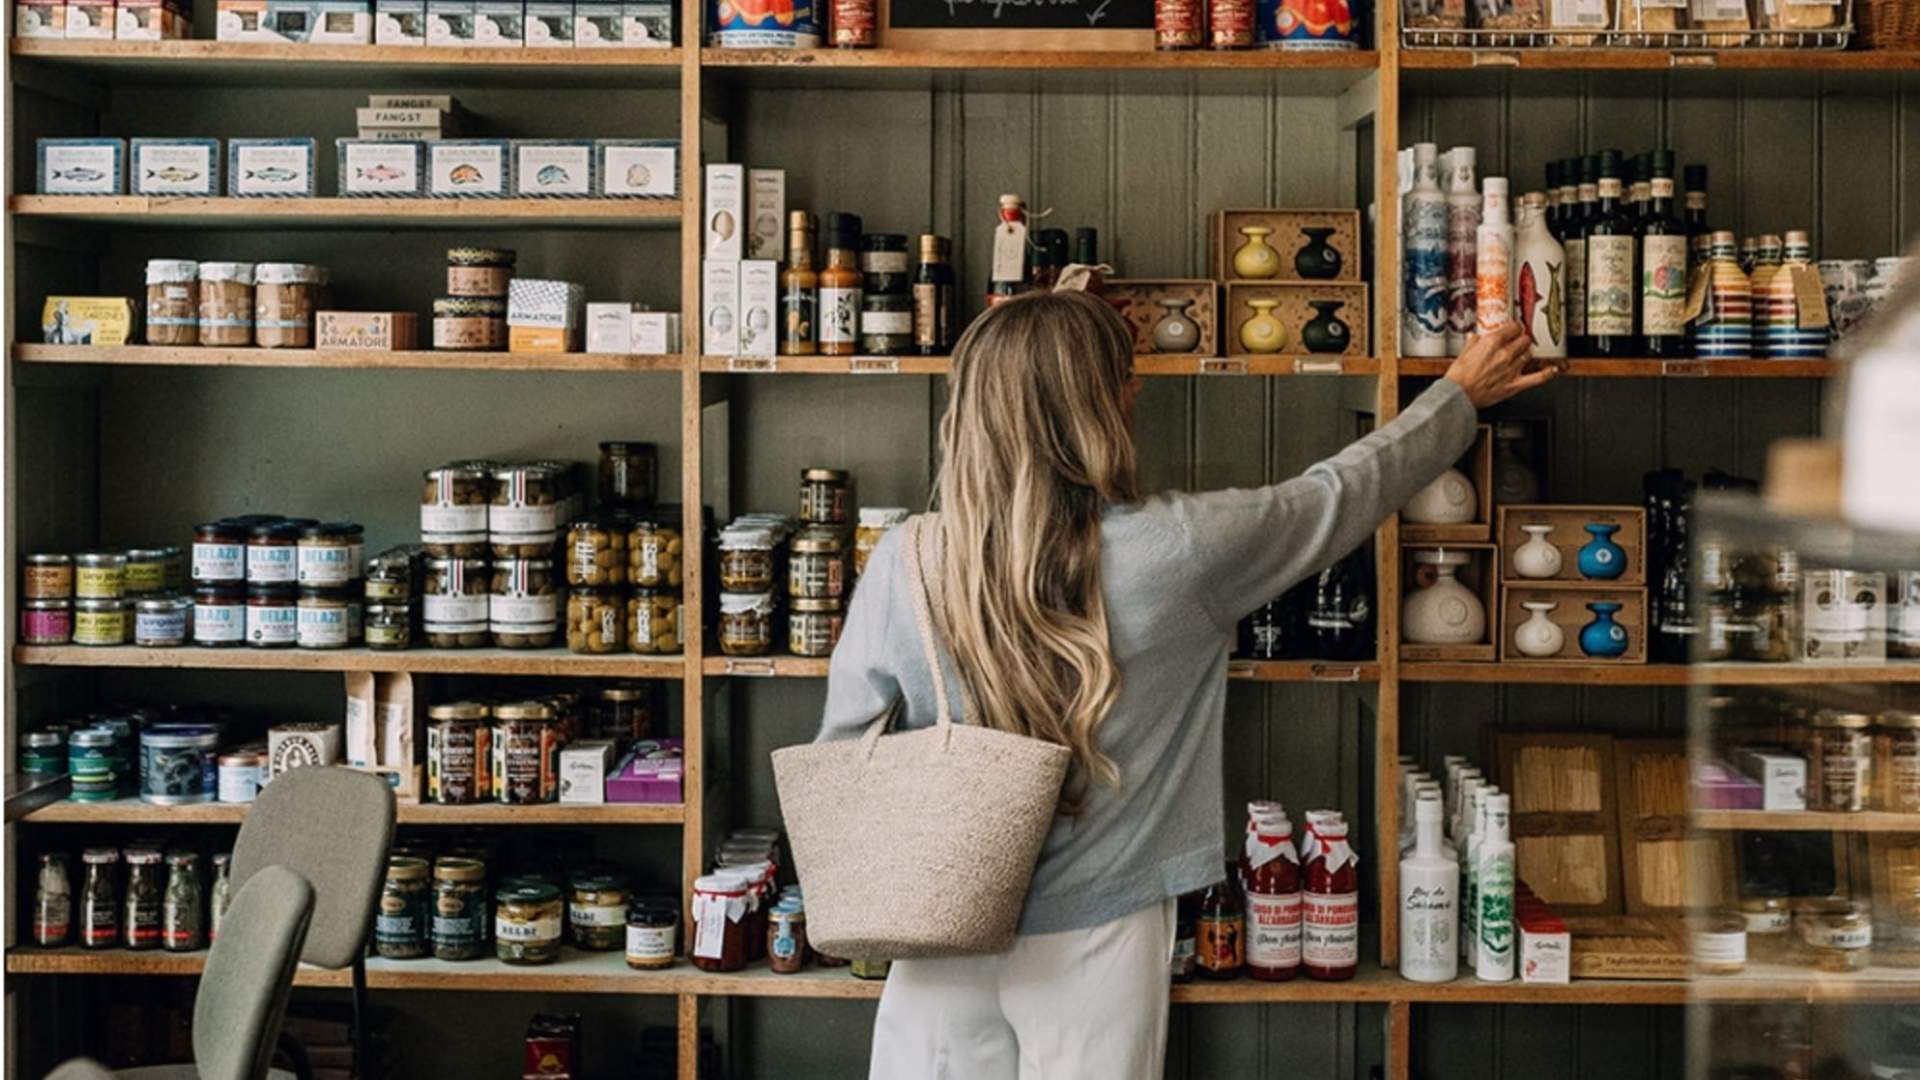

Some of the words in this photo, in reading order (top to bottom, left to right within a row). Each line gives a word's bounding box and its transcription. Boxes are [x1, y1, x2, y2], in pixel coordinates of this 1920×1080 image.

[387, 99, 432, 108] FANGST
[375, 112, 422, 122] FANGST
[511, 312, 563, 323] ARMATORE
[321, 336, 387, 348] ARMATORE
